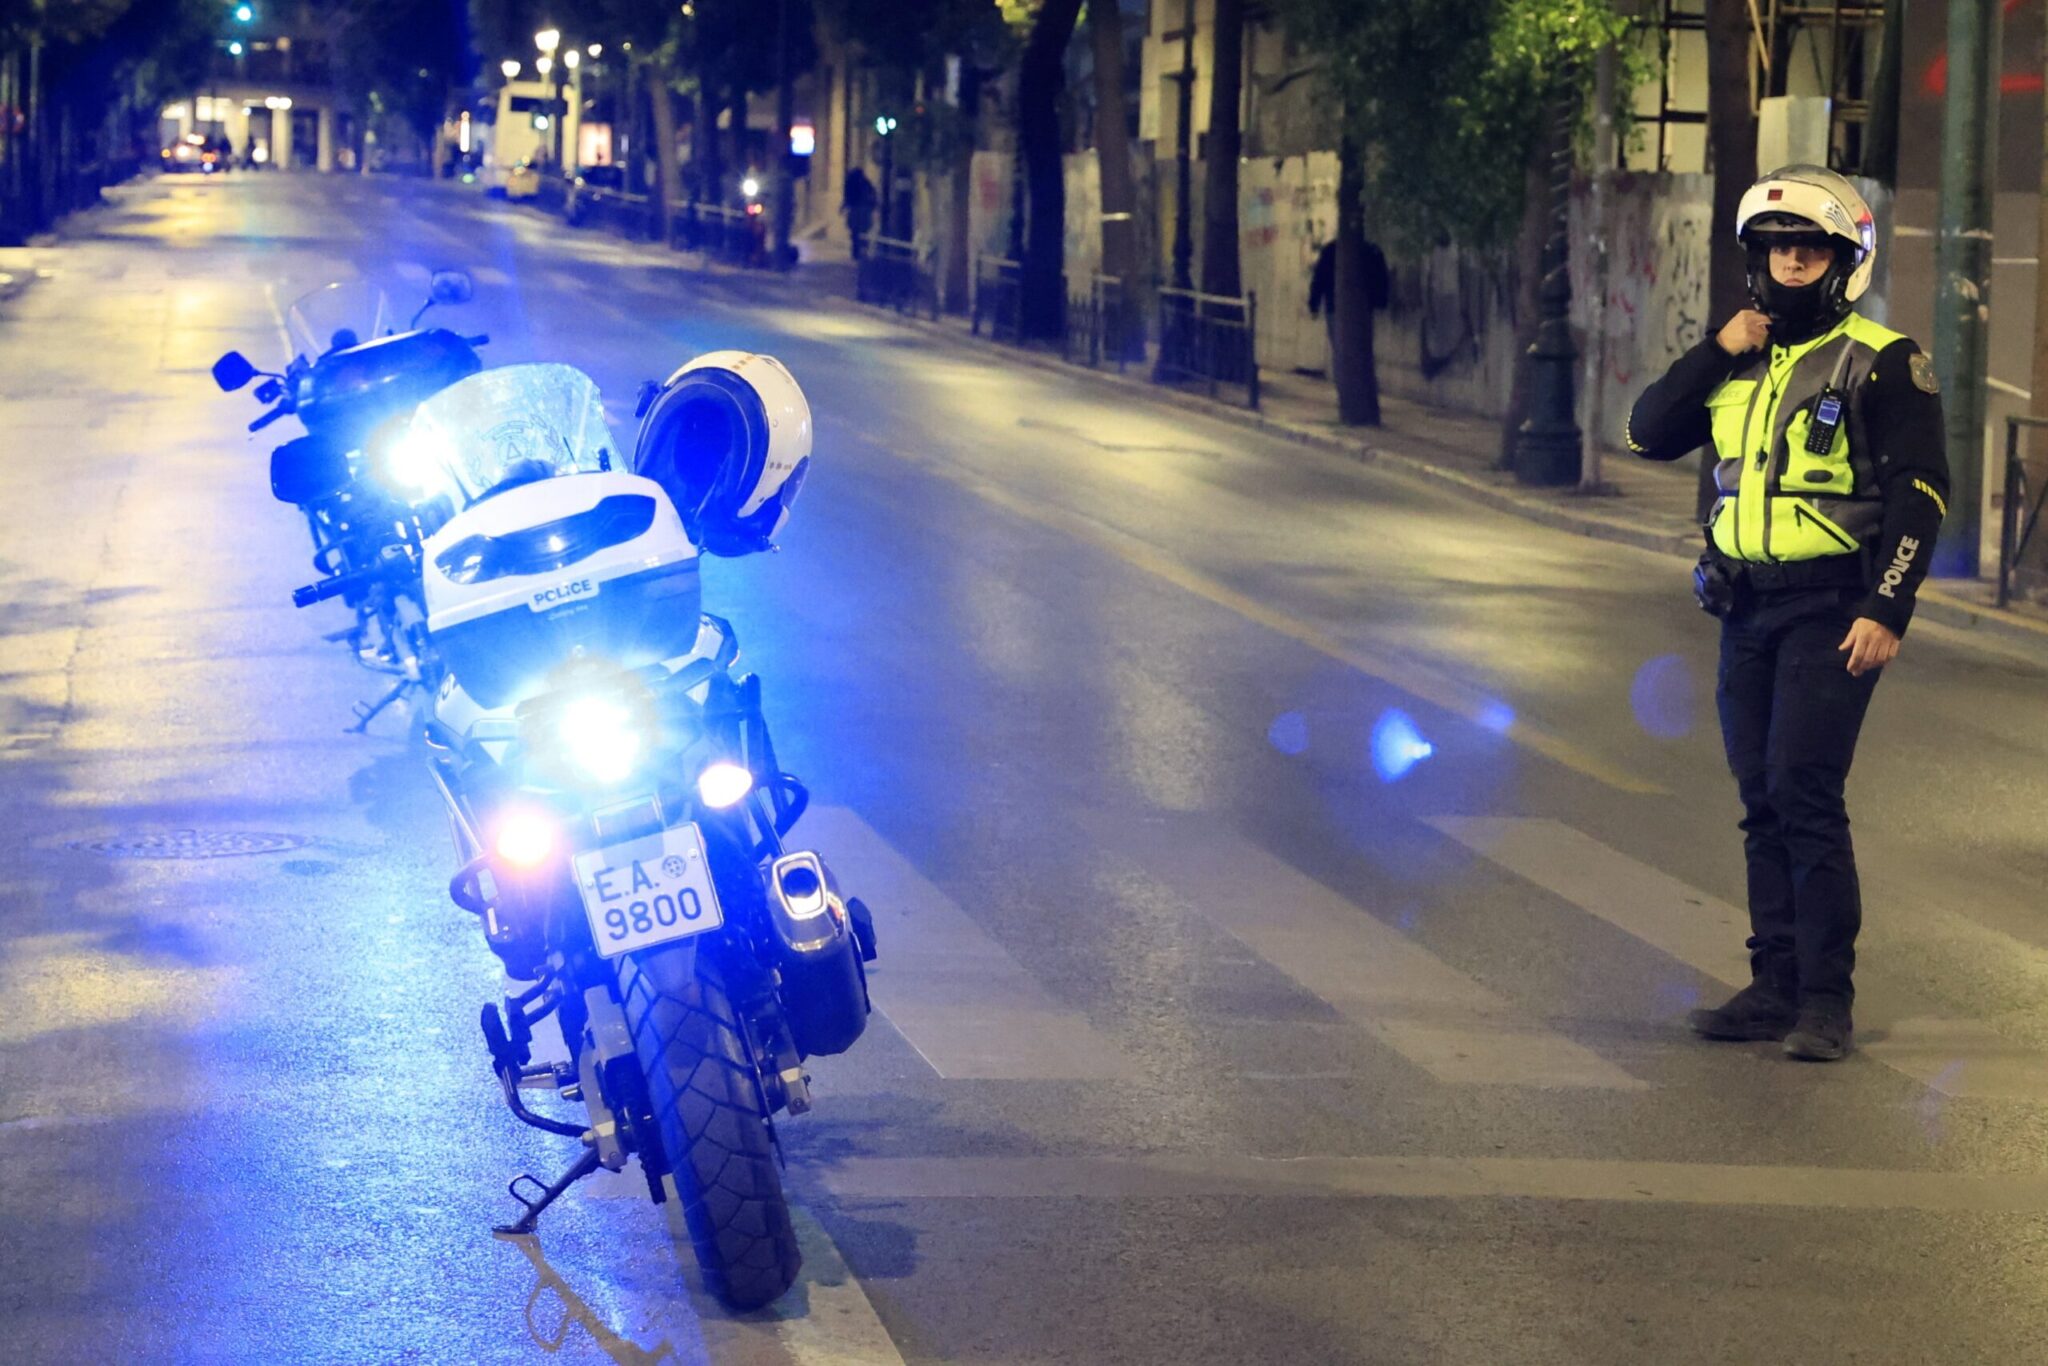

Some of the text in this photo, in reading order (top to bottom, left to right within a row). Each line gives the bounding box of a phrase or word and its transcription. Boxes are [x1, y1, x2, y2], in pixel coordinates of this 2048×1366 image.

[534, 579, 592, 605] POLICE
[1878, 535, 1920, 598] POLICE
[604, 887, 702, 940] 9800
